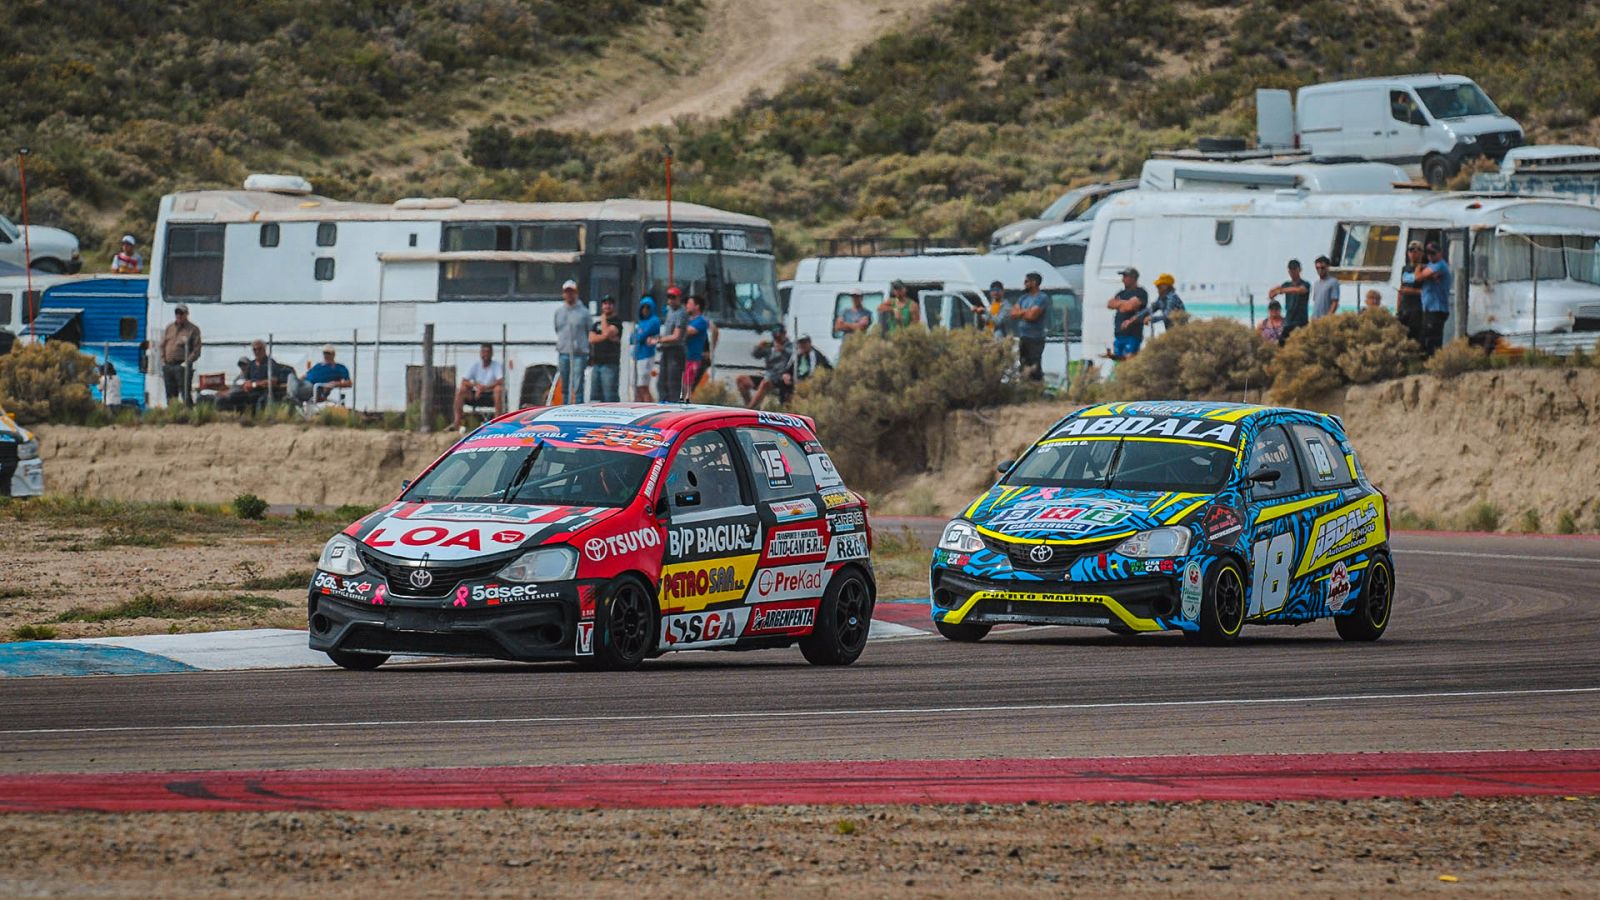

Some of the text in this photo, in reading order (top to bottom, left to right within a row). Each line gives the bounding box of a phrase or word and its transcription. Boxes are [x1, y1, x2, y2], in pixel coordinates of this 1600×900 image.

[1048, 416, 1238, 443] ABDALA
[760, 450, 785, 478] 15
[1309, 443, 1331, 475] 18
[444, 503, 518, 514] MM
[1008, 522, 1086, 531] CARSERVICE
[1310, 502, 1379, 566] ABDALA
[364, 526, 481, 551] LOA
[606, 526, 661, 556] TSUYOI
[769, 540, 805, 556] AUTO-CAM
[837, 539, 862, 558] R&G
[775, 569, 821, 592] PreKad
[1246, 532, 1294, 618] 18
[472, 584, 538, 601] 5asec
[500, 592, 560, 603] TEXTILE EXPERT
[1041, 593, 1104, 603] MADRYN
